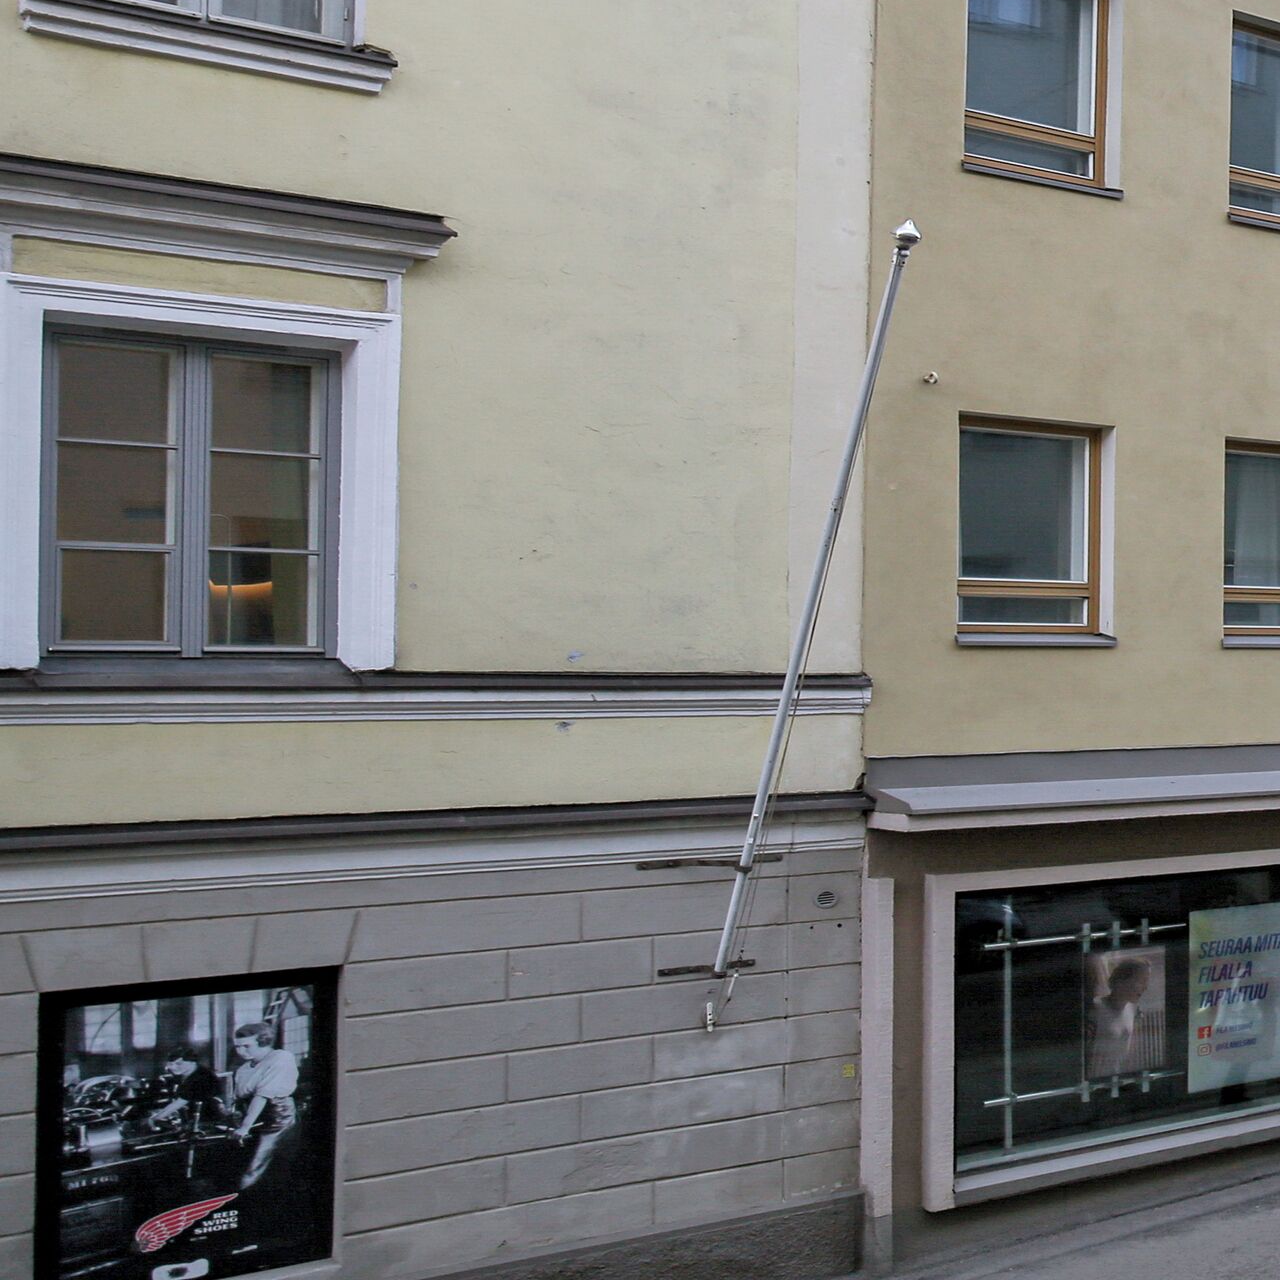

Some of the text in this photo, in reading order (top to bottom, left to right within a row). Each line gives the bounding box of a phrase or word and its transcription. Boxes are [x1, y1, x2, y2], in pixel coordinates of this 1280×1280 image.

[1199, 935, 1252, 959] SEURAA
[1199, 960, 1253, 983] FILALLA
[1200, 983, 1268, 1009] TAPAHTUU
[202, 1216, 238, 1227] WING
[213, 1210, 239, 1219] RED
[194, 1222, 238, 1235] SHOES
